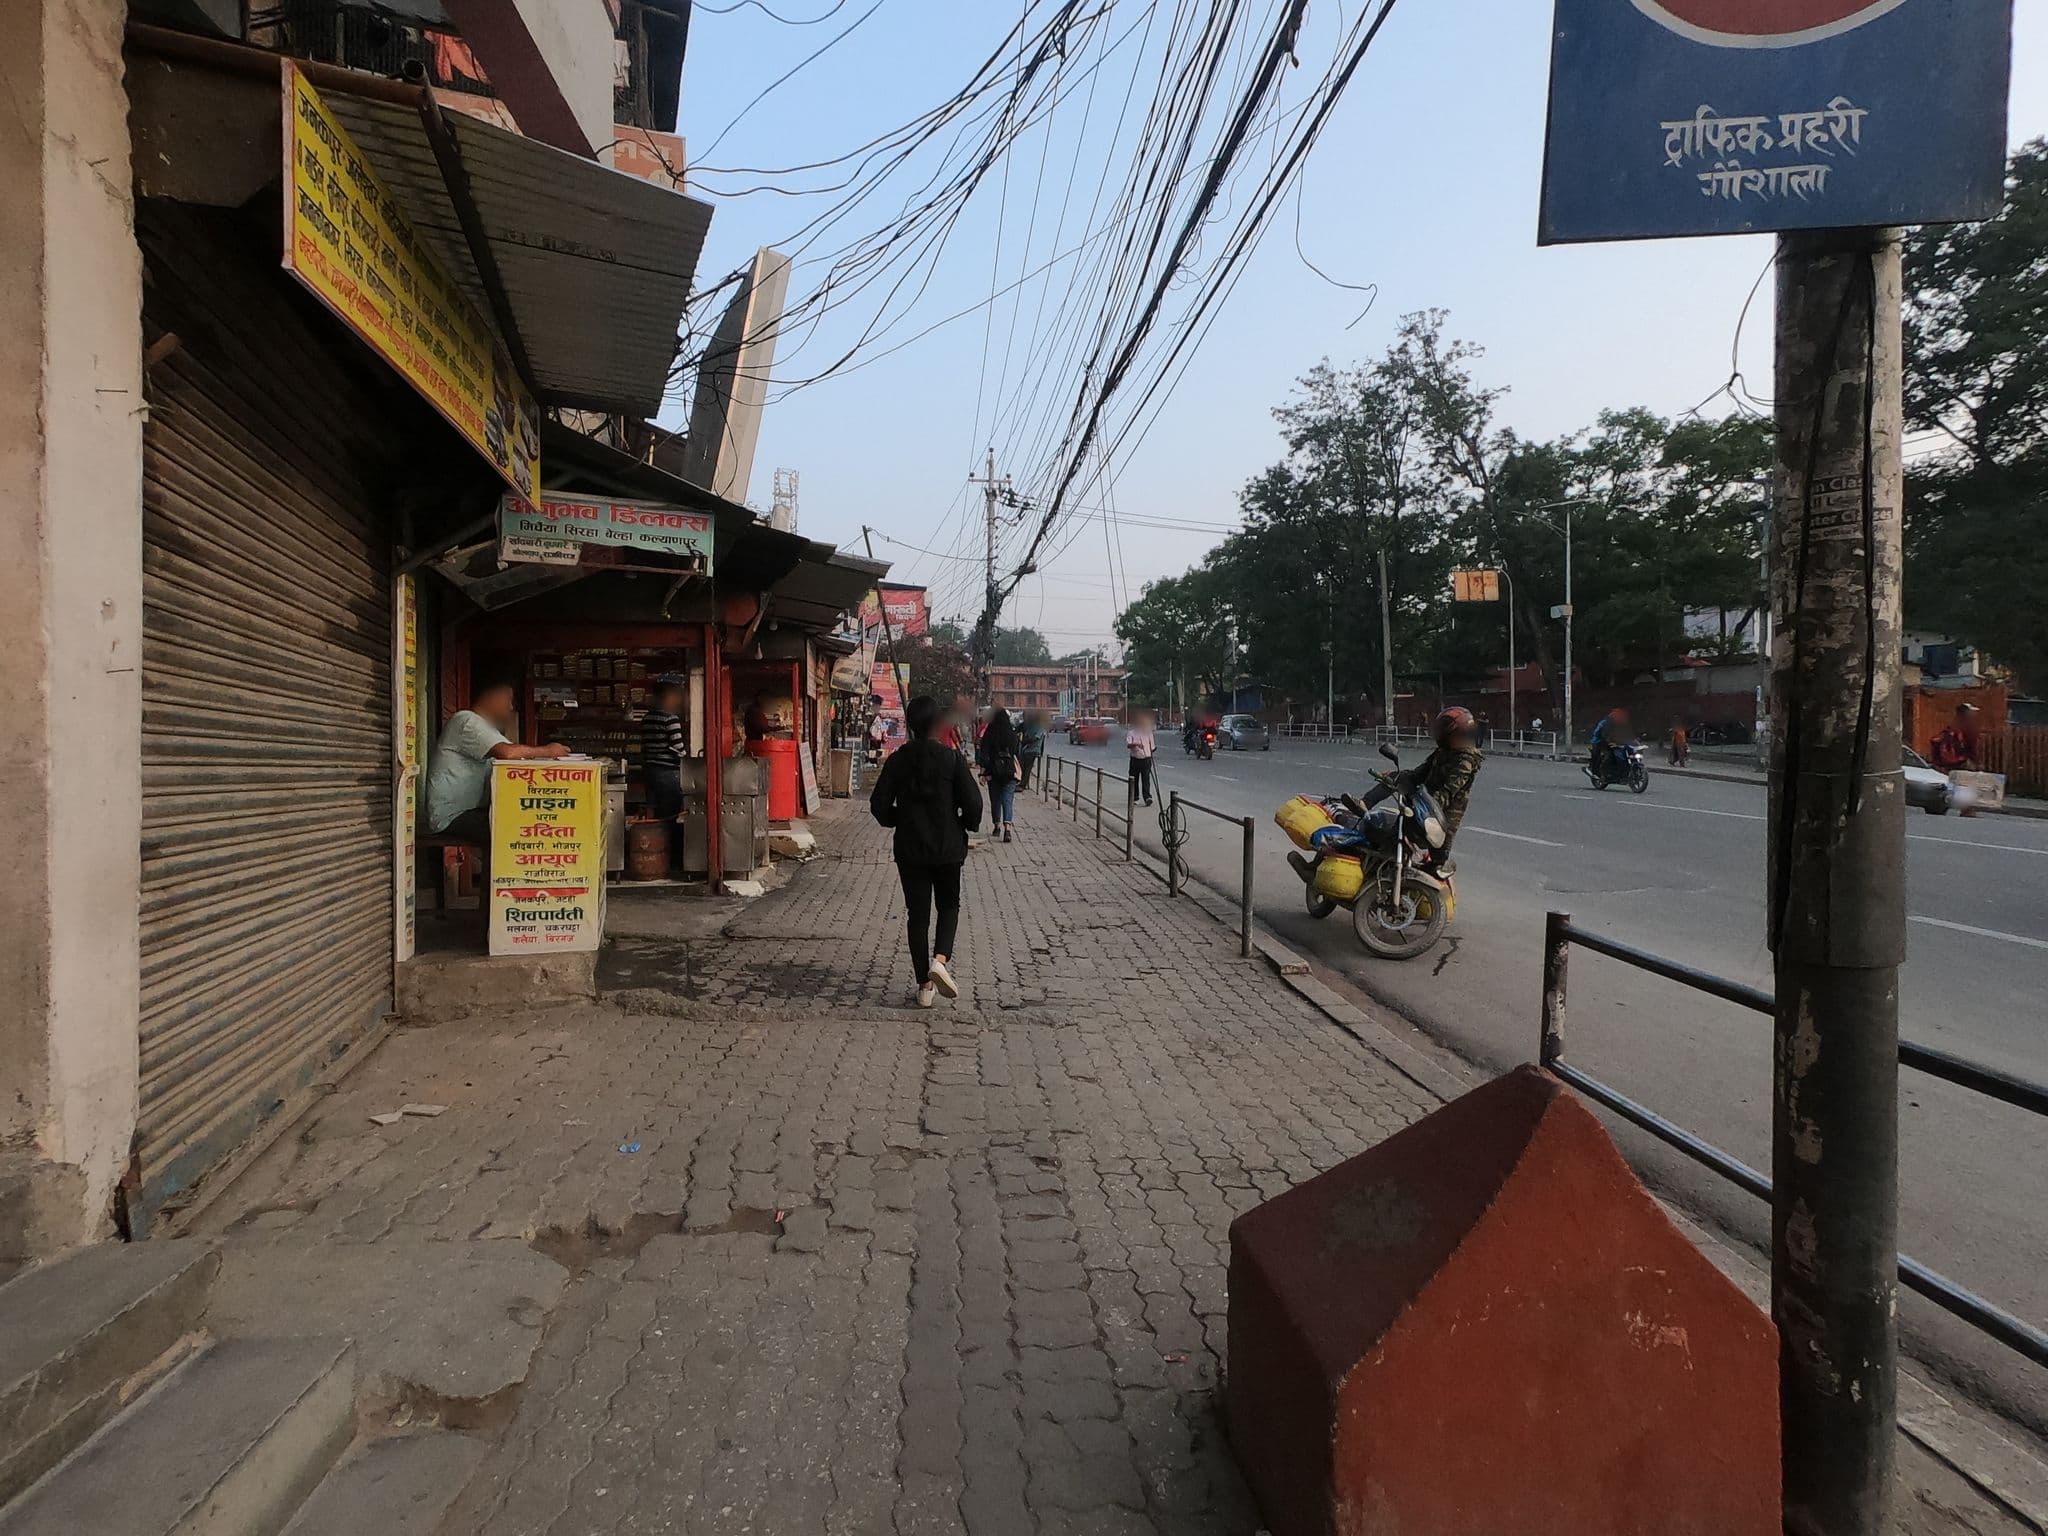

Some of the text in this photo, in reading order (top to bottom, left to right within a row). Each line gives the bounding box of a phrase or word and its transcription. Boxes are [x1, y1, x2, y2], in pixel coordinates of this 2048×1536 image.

[1660, 96, 1869, 168] ट्राफिक प्रहरी
[506, 767, 594, 785] न्यू सपना
[527, 785, 570, 796] विराटनगर
[519, 797, 577, 811] प्राइम
[519, 823, 576, 838] उदिता
[552, 841, 582, 852] भोजपुर
[515, 854, 578, 867] आयूष
[505, 907, 584, 922] शिवपार्वती
